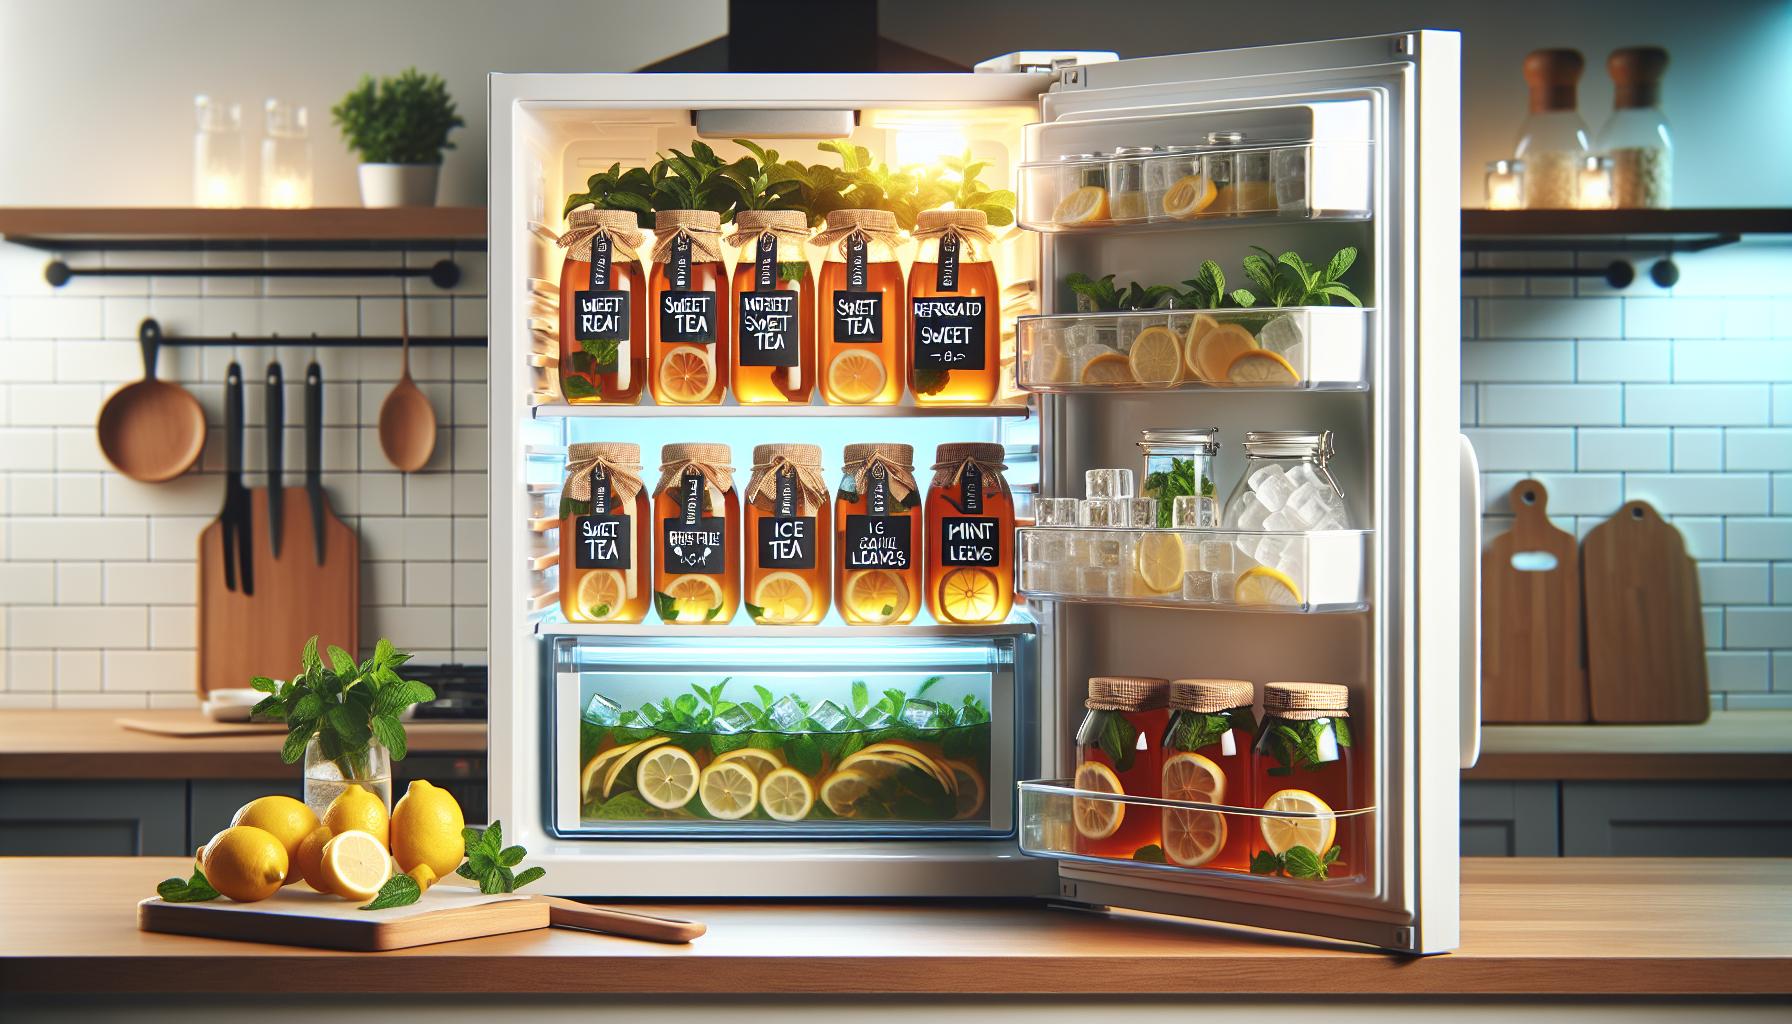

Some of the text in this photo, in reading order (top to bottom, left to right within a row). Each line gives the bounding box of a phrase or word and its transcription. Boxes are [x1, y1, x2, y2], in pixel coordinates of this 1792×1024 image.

[675, 315, 708, 333] TEA
[841, 317, 875, 336] TEA
[753, 332, 785, 351] TEA
[775, 521, 804, 538] ICE
[584, 539, 619, 560] TEA
[768, 539, 803, 560] TEA
